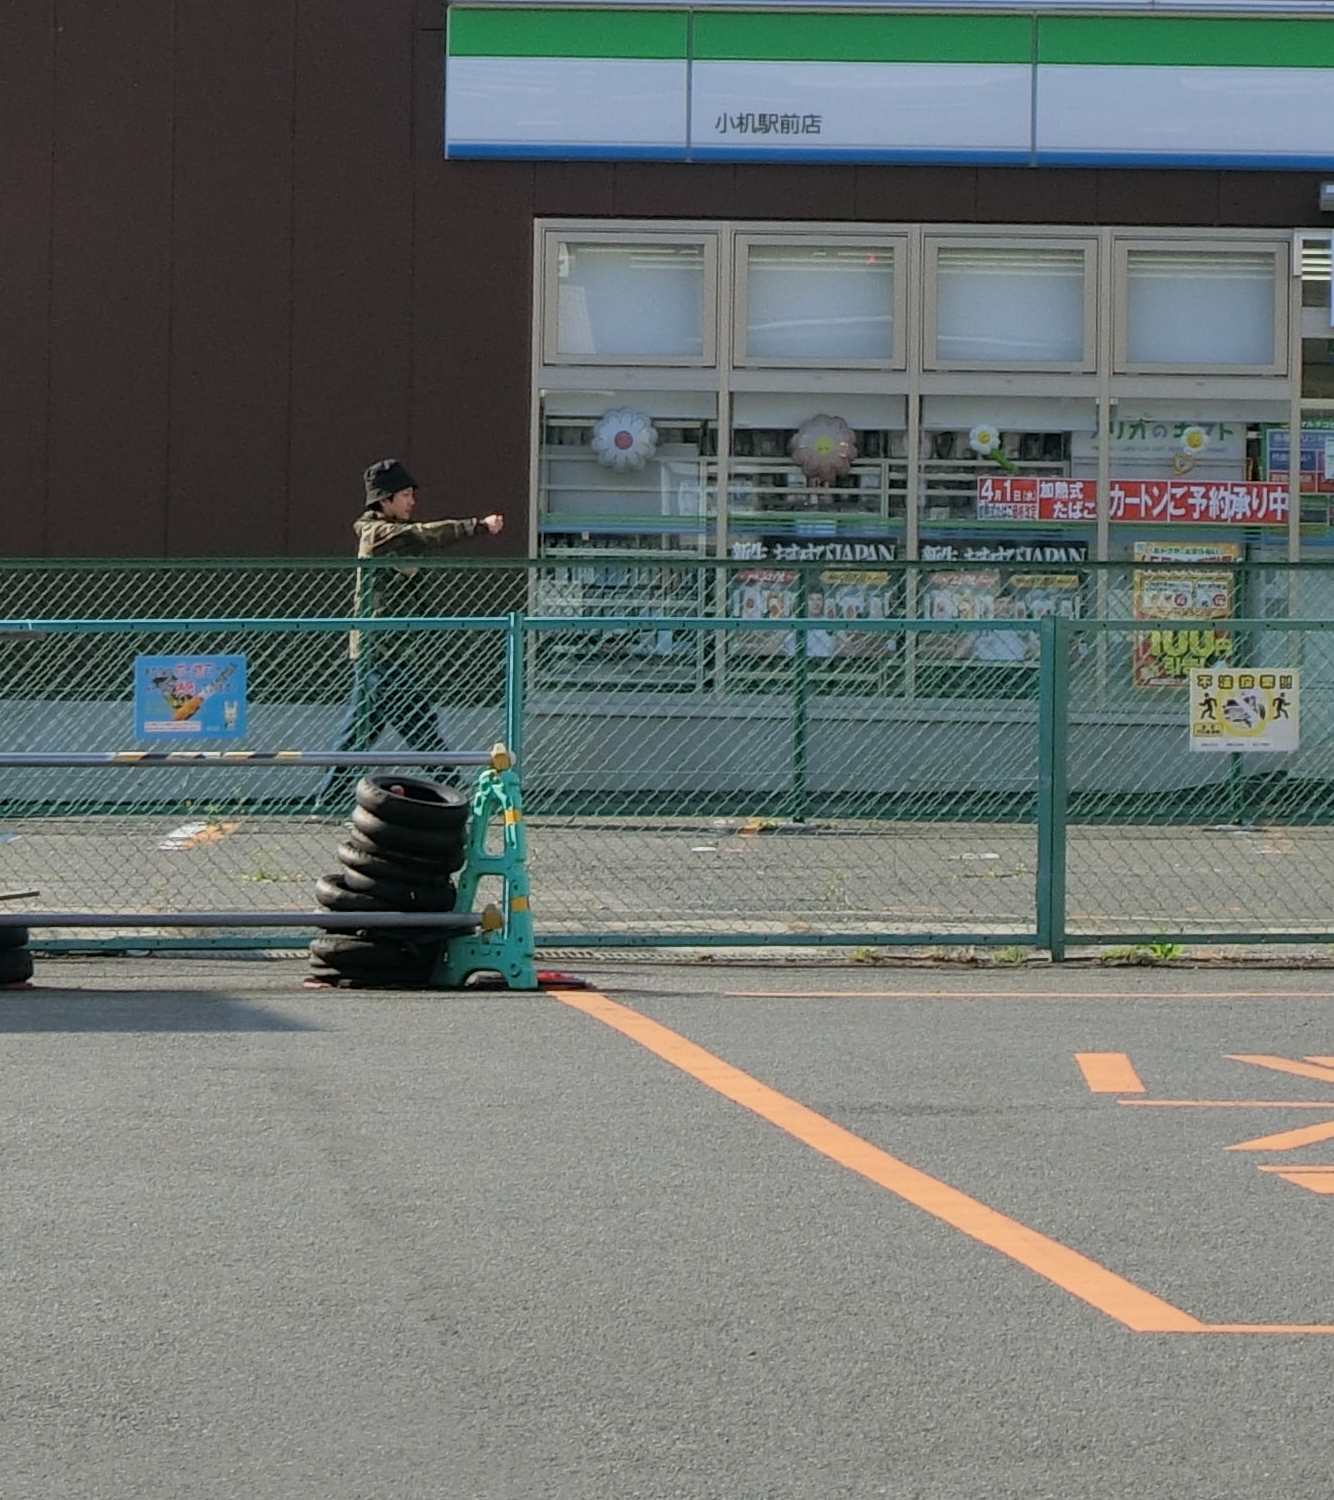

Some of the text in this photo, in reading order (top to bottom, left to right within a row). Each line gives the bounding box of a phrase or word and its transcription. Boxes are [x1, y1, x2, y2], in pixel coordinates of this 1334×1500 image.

[714, 111, 822, 135] 小机駅前店
[1053, 501, 1098, 519] たばこ
